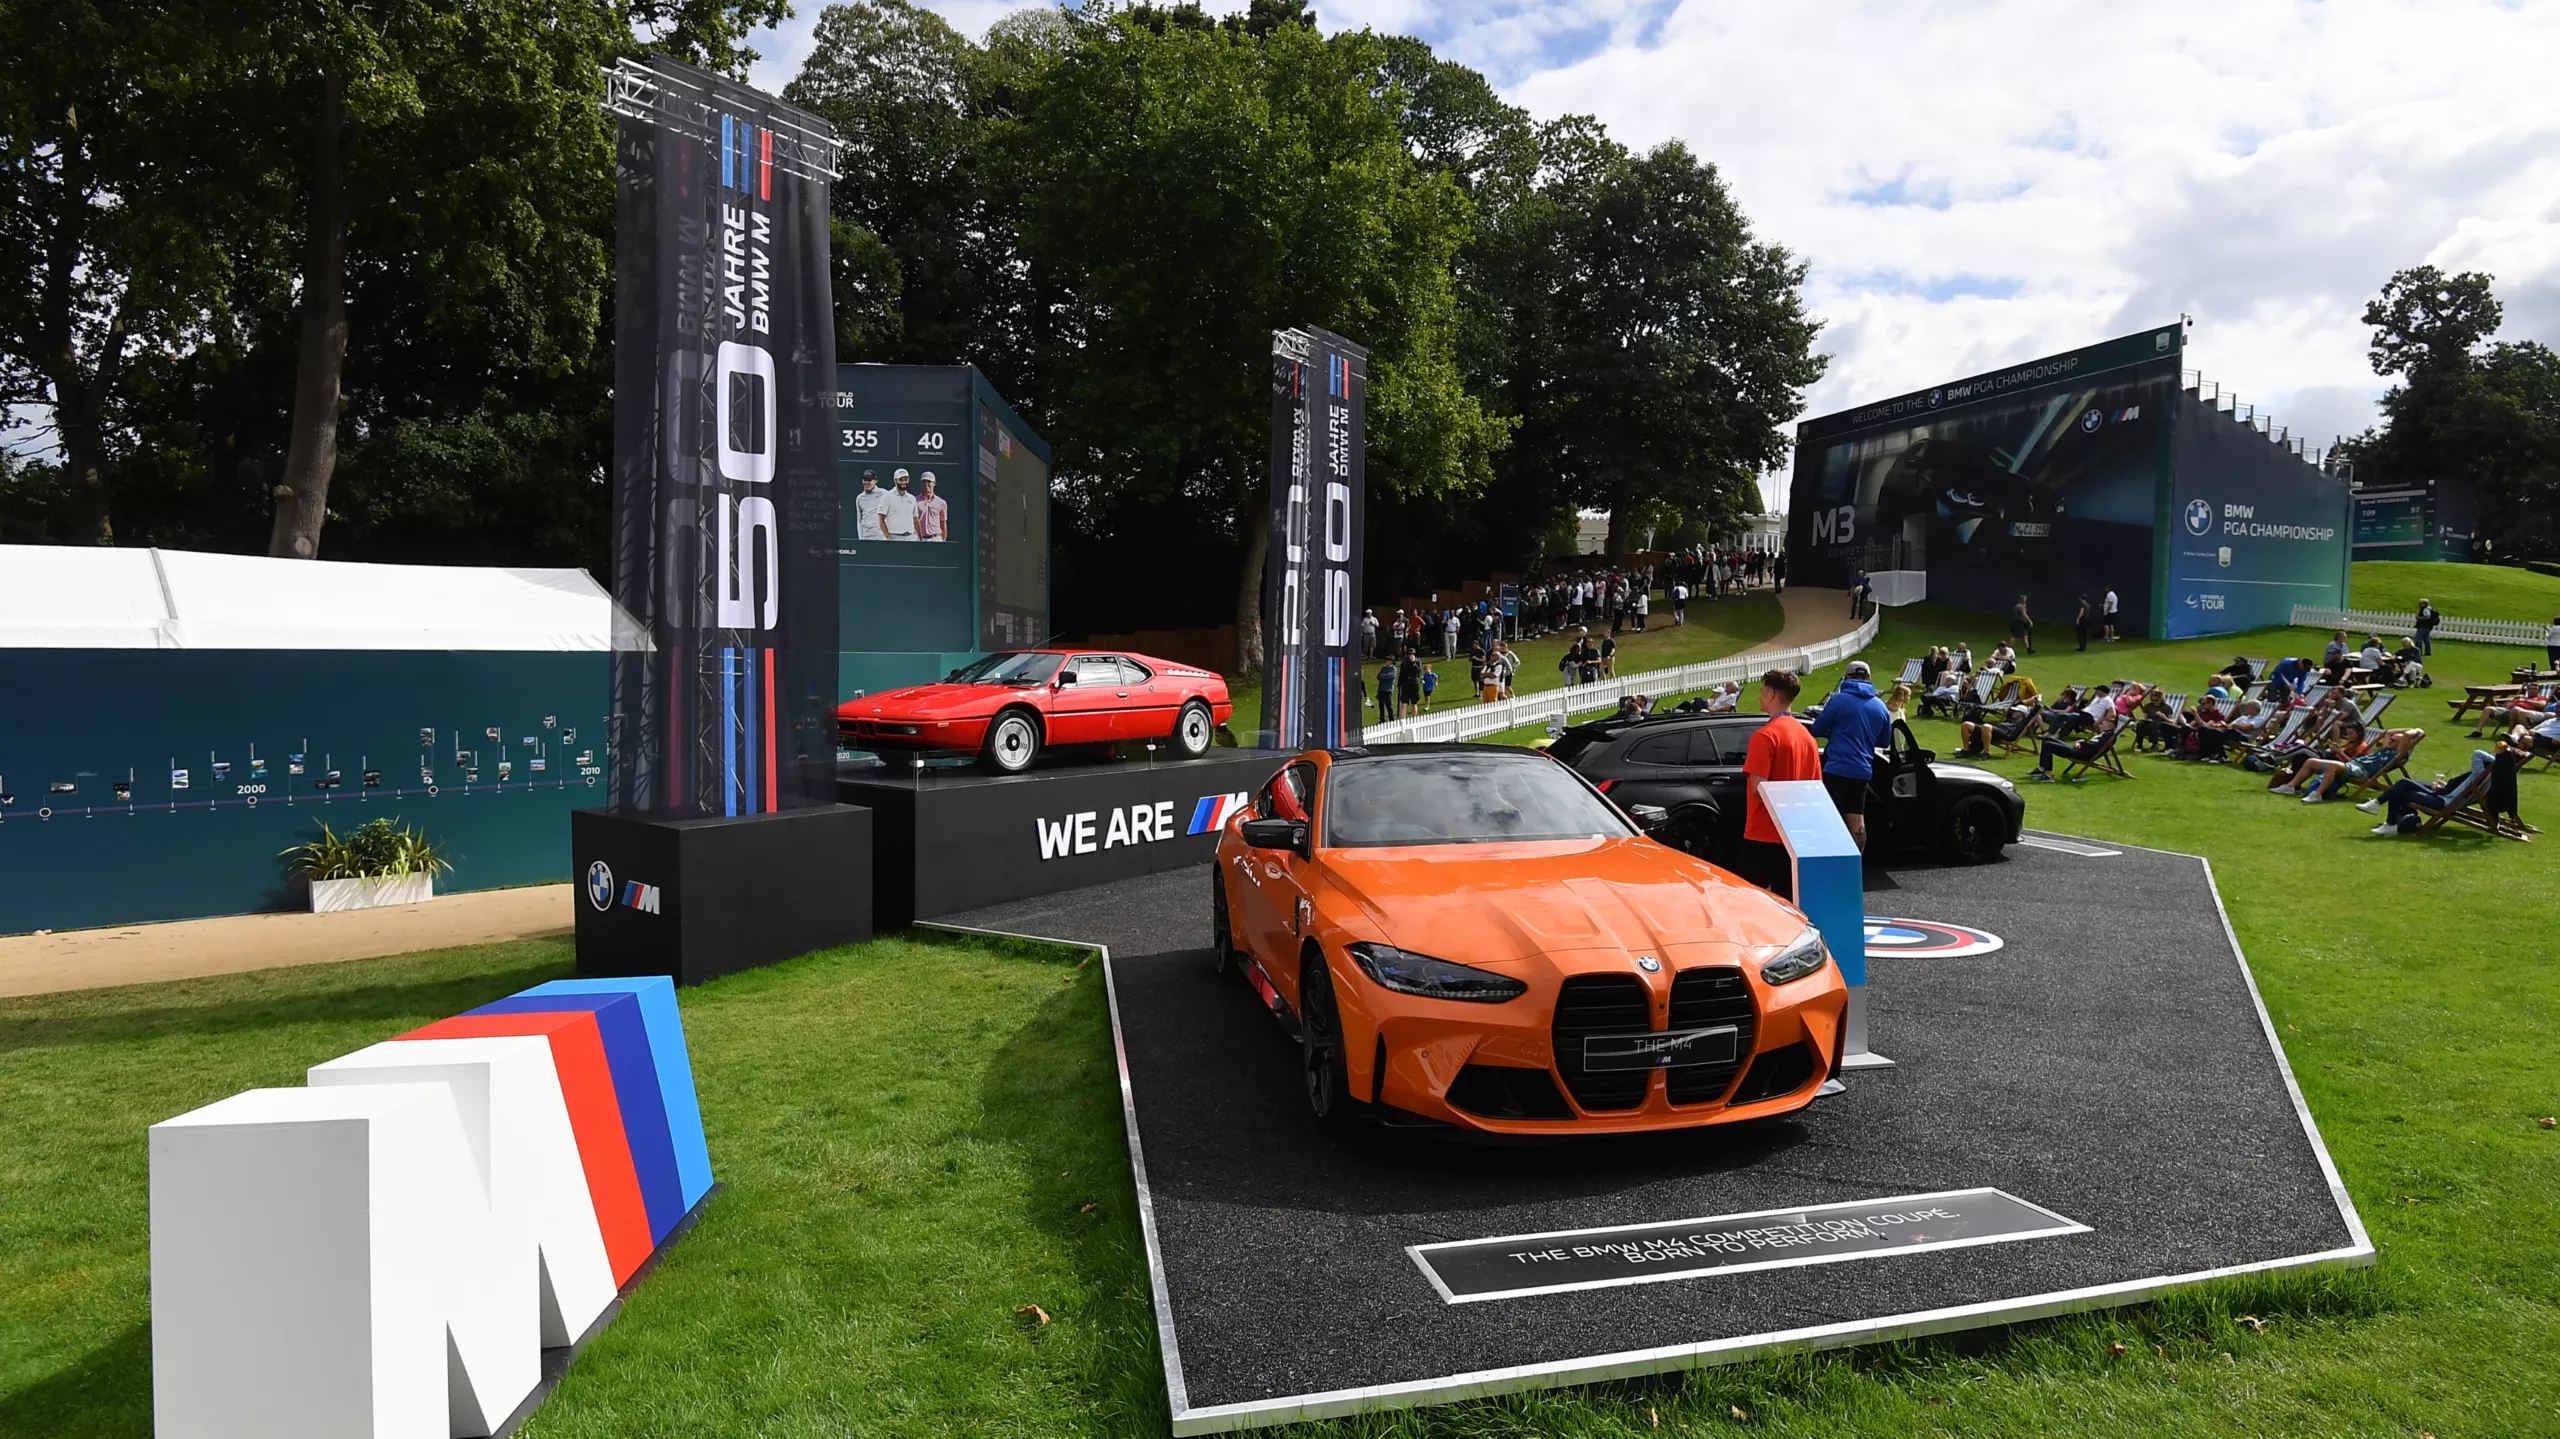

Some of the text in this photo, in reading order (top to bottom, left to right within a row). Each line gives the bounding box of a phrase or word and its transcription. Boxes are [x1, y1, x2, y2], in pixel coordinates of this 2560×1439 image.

[751, 211, 771, 335] BMW M
[1852, 357, 2078, 425] WELCOME TO THE BMW PGA CHAMPIONSHIP
[717, 202, 779, 631] 50 JAHRE
[842, 429, 878, 448] 355
[917, 432, 944, 450] 40
[1325, 404, 1350, 648] 50 JAHRE
[1812, 504, 1856, 547] M3
[2224, 504, 2255, 519] BMW
[2224, 521, 2334, 541] PGA CHAMPIONSHIP
[2200, 599, 2225, 611] TOUR
[580, 766, 601, 776] 2010
[237, 784, 266, 794] 2000
[1036, 810, 1097, 860] WE
[1103, 800, 1175, 850] ARE
[1633, 1037, 1692, 1054] THE M4
[1508, 1248, 1571, 1264] THE
[1572, 1240, 1640, 1259] BMW
[1643, 1236, 1686, 1251] M4
[1688, 1217, 1865, 1247] COMPETITION
[1623, 1226, 1886, 1264] BORN TO PERFORM.
